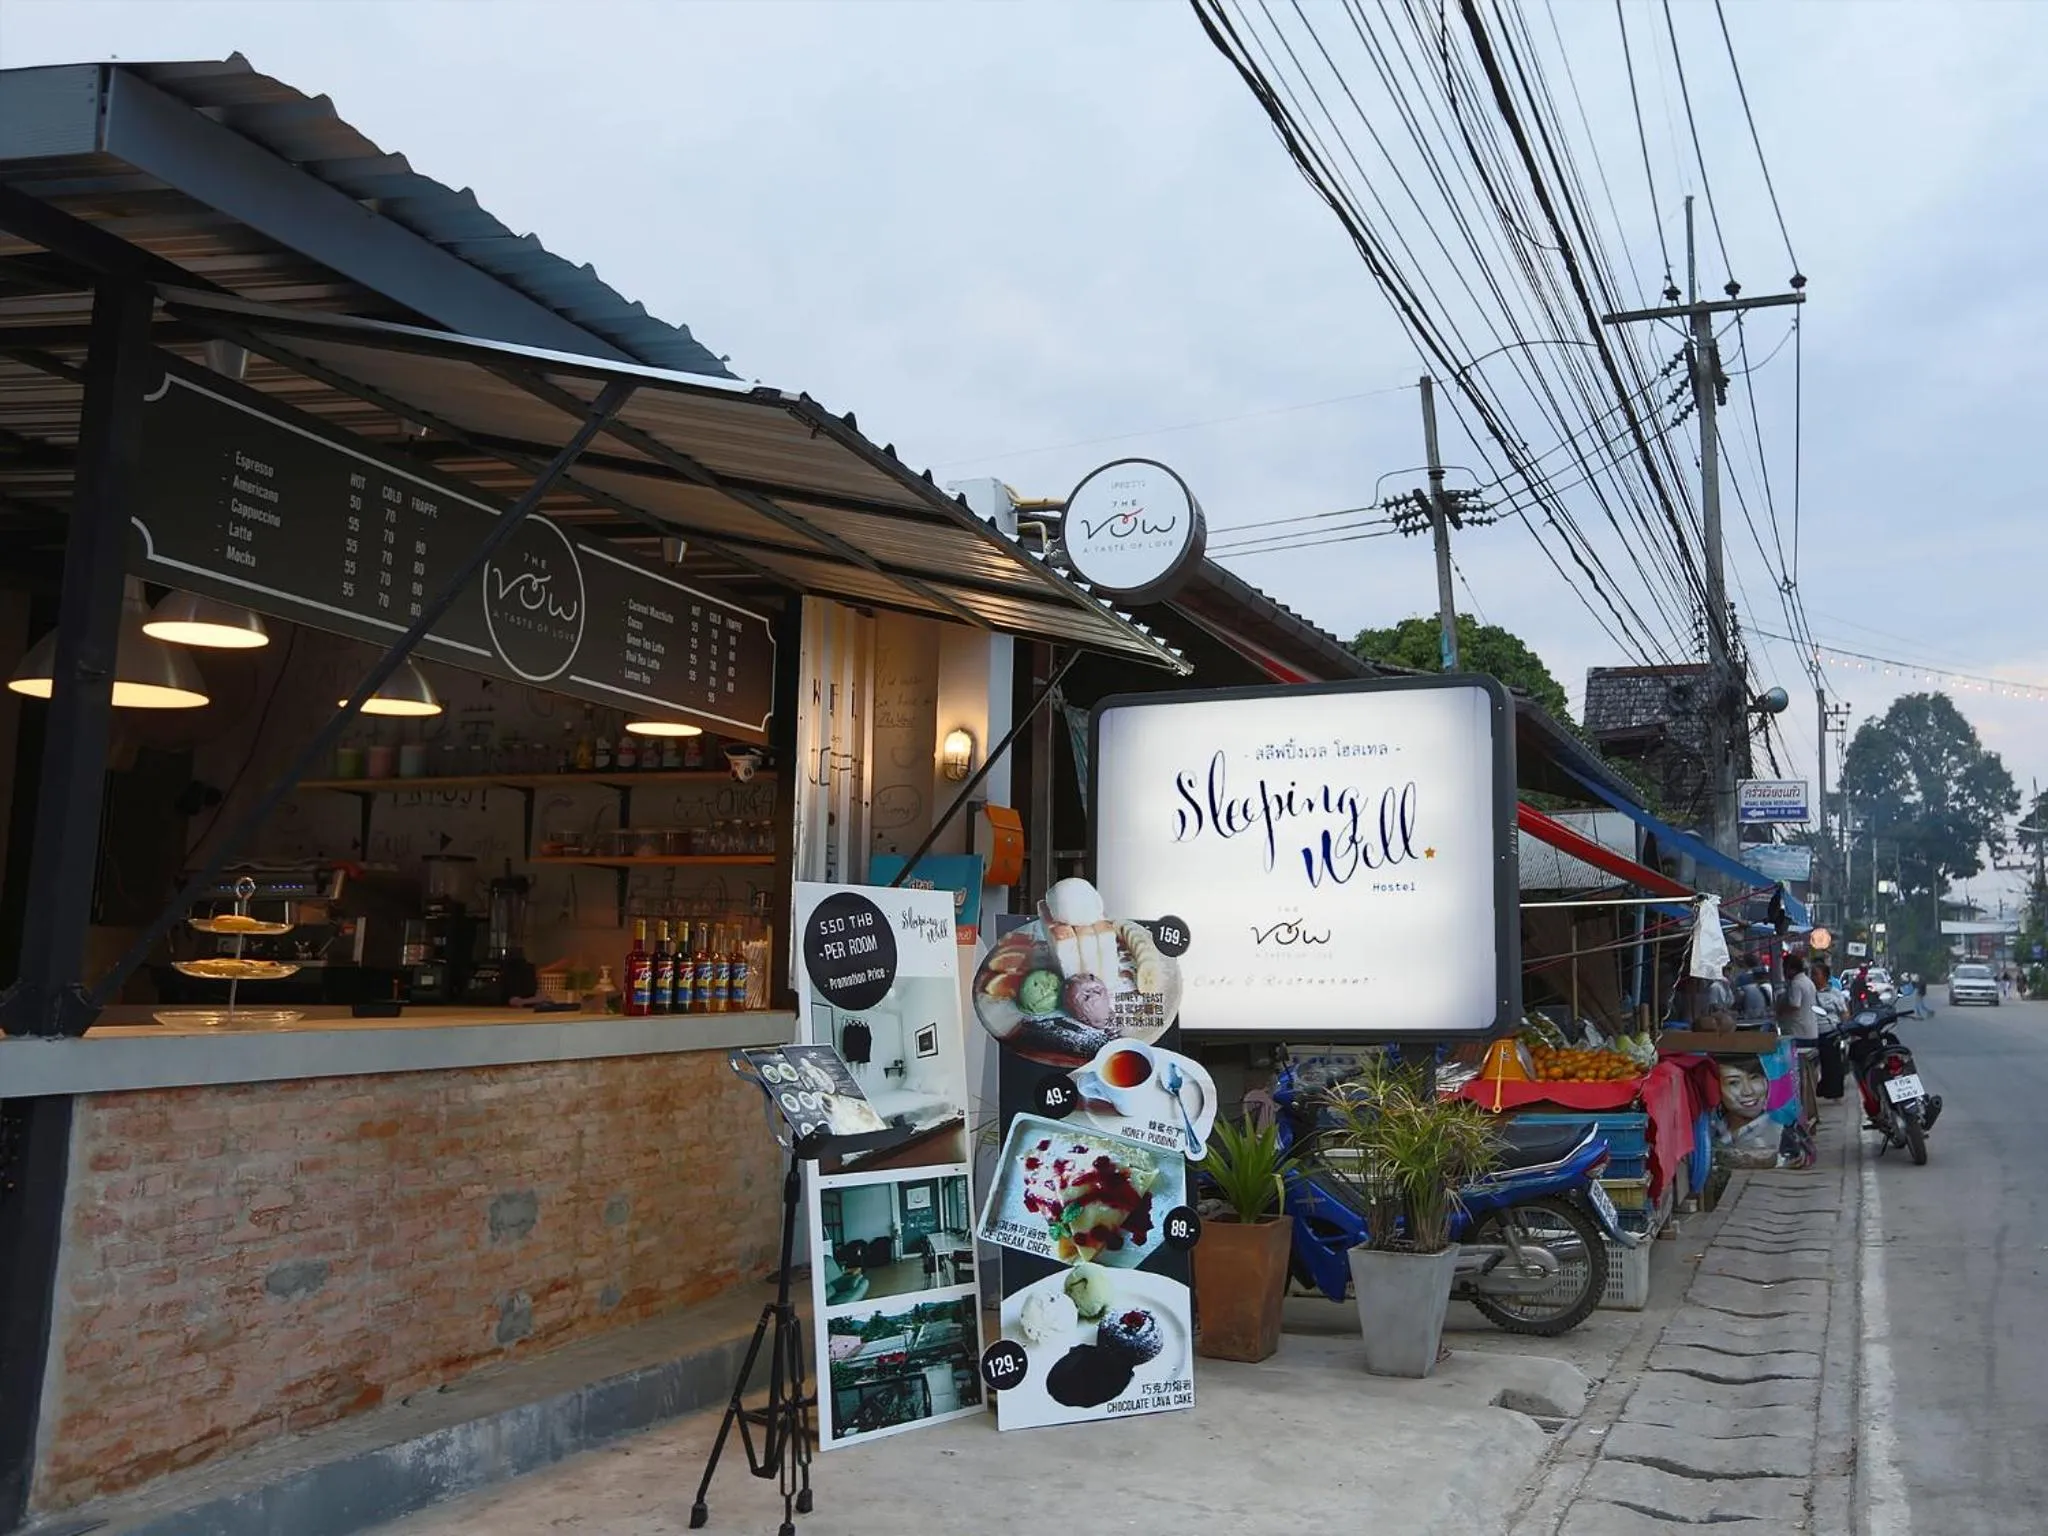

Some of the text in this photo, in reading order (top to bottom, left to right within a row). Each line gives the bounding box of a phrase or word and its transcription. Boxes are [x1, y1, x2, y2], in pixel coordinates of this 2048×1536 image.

[235, 451, 274, 477] Espresso
[232, 475, 279, 503] Americano
[350, 472, 438, 518] HOT COLD FRAPPE
[231, 498, 281, 528] Cappuccino
[350, 496, 396, 524] 50 70
[1112, 499, 1137, 508] THE
[229, 522, 252, 542] Latte
[348, 516, 426, 556] 55 70 80
[226, 545, 256, 567] Mocha
[346, 538, 425, 576] 55 70 80
[523, 552, 547, 569] THE
[344, 560, 423, 597] 55 70 80
[342, 582, 422, 618] 55 70 80
[652, 641, 665, 654] Latte
[1170, 750, 1367, 874] Sleeping
[1301, 781, 1419, 889] Well
[1372, 881, 1416, 892] Hostel
[820, 912, 874, 935] 550 THB
[849, 934, 878, 954] ROOM
[830, 968, 886, 991] Promotion Price
[1114, 992, 1139, 1002] HONEY
[1121, 1126, 1178, 1148] HONEY PUDDING
[1027, 1240, 1052, 1256] CREPE
[1106, 1392, 1192, 1413] CHOCOLATE LAVA CAKE
